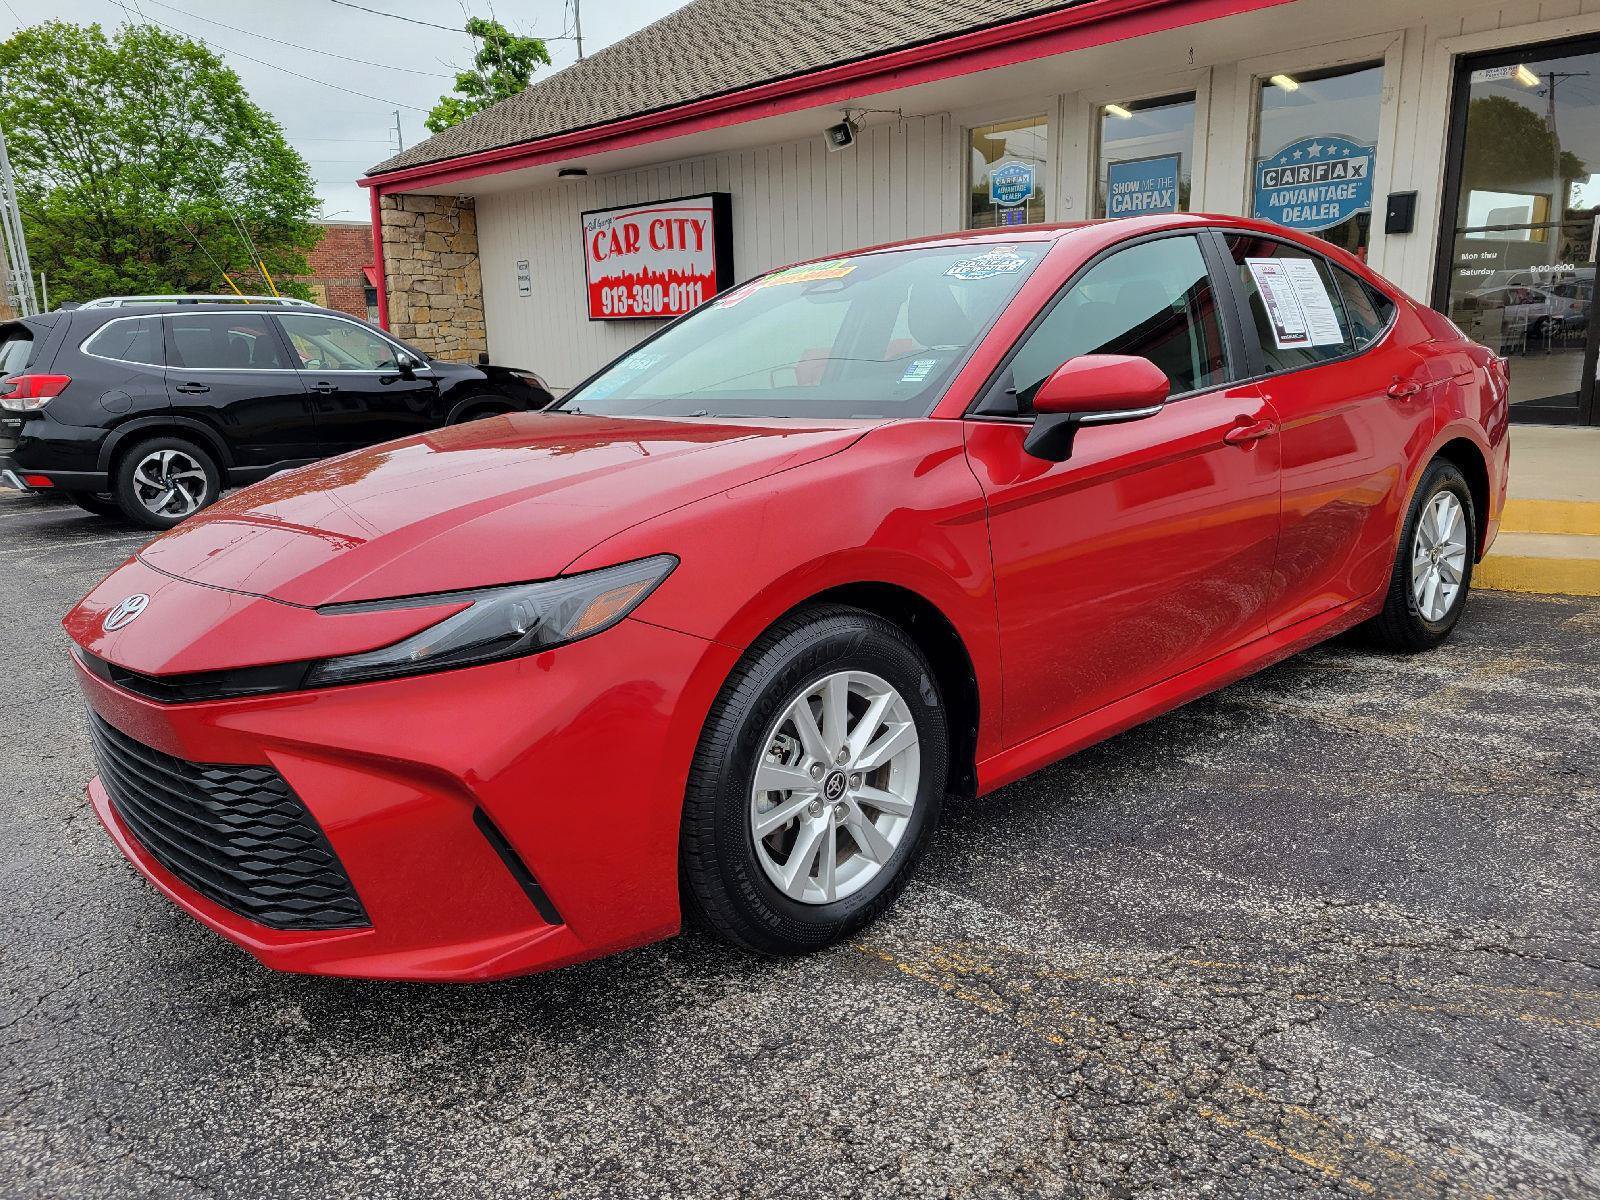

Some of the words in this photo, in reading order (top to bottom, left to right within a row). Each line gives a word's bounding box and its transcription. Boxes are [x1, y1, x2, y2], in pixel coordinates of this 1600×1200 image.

[995, 176, 1029, 186] CARFAX
[1263, 159, 1367, 188] CARFAX
[1112, 180, 1140, 194] SHOW
[1142, 178, 1155, 190] ME
[1157, 176, 1173, 189] THE
[1269, 182, 1357, 207] ADVANTAGE
[1112, 189, 1174, 213] CARFAX
[1282, 202, 1340, 223] DEALER
[592, 223, 640, 262] CAR
[649, 218, 707, 252] CITY
[1461, 252, 1479, 260] Mon
[1480, 251, 1498, 259] thru
[1460, 267, 1496, 276] Saturday
[601, 281, 703, 314] 913-390-0111
